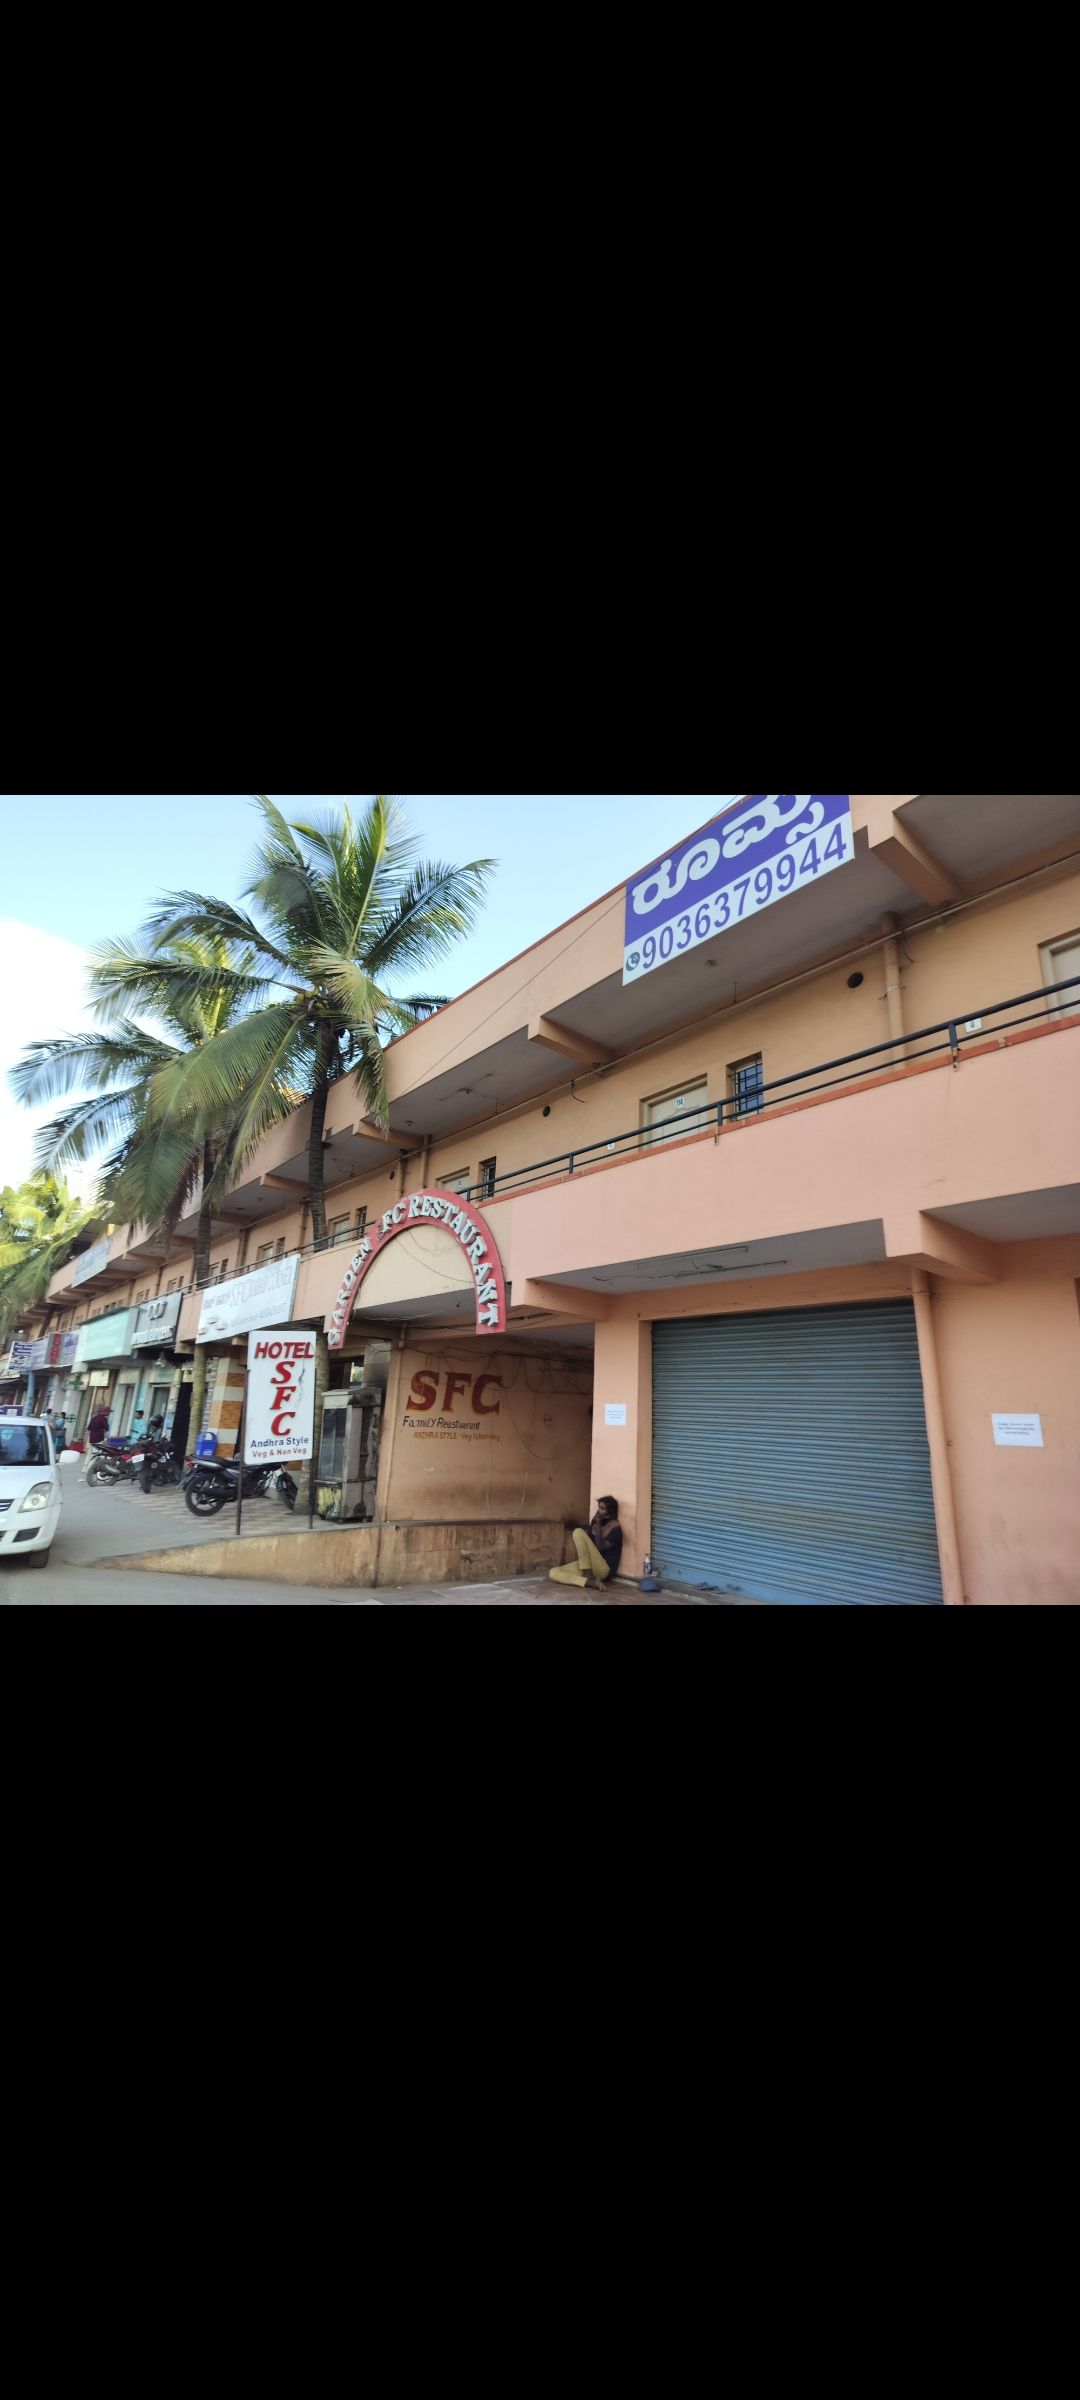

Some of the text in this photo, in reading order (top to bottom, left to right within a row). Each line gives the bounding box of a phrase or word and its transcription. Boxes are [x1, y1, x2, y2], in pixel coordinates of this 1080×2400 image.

[642, 822, 847, 970] 9036379944
[328, 1236, 372, 1346] GARDEN
[408, 1195, 498, 1328] RESTAURANT
[254, 1341, 315, 1359] HOTEL
[406, 1369, 503, 1415] SFC
[250, 1436, 309, 1448] Andhra Style
[252, 1450, 267, 1458] Veg
[276, 1448, 292, 1456] Non
[293, 1447, 307, 1455] Veg
